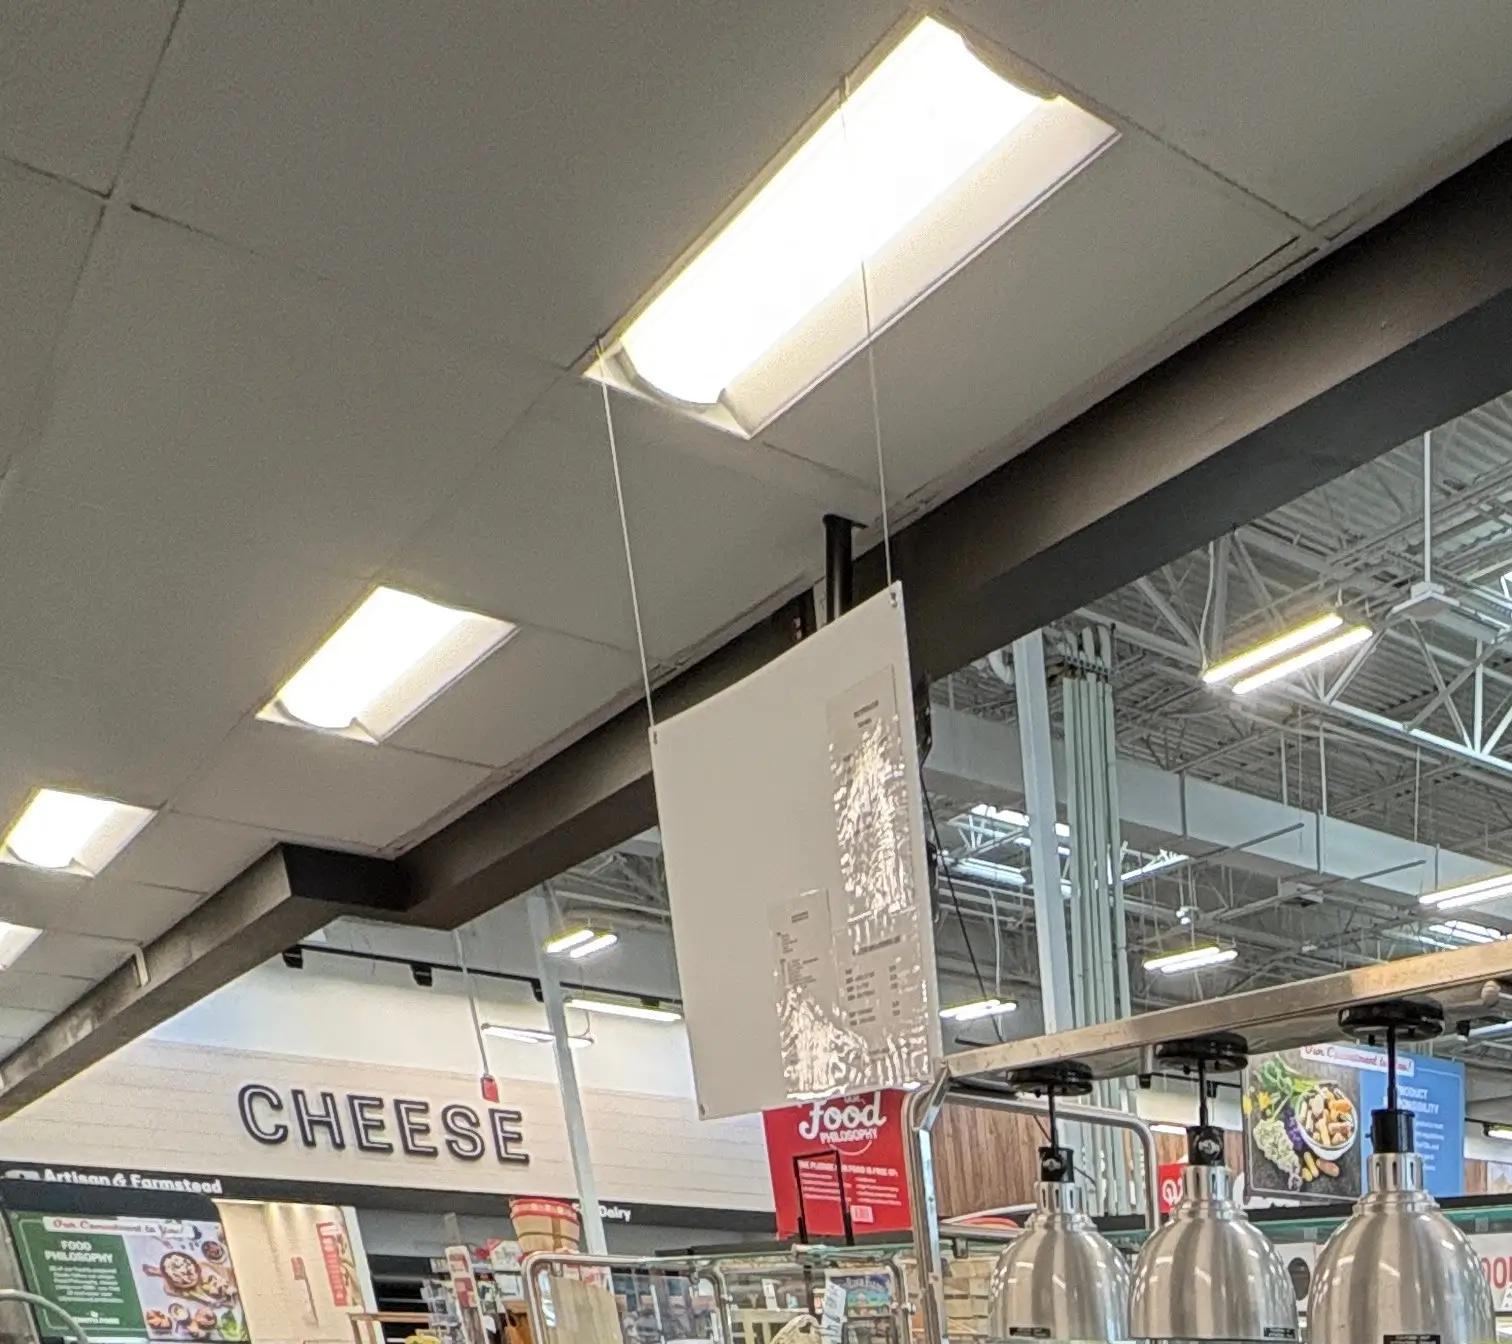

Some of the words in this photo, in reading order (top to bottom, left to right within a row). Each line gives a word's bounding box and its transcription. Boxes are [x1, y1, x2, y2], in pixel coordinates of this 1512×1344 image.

[237, 1083, 530, 1165] CHEESE
[820, 1127, 877, 1145] PHILOSOPHY
[43, 1168, 110, 1187] Artisan
[112, 1172, 127, 1187] &
[130, 1173, 223, 1194] Farmstead
[600, 1205, 632, 1222] Dairy
[60, 1240, 92, 1251] FOOD
[44, 1250, 113, 1264] PHILOSOPHY
